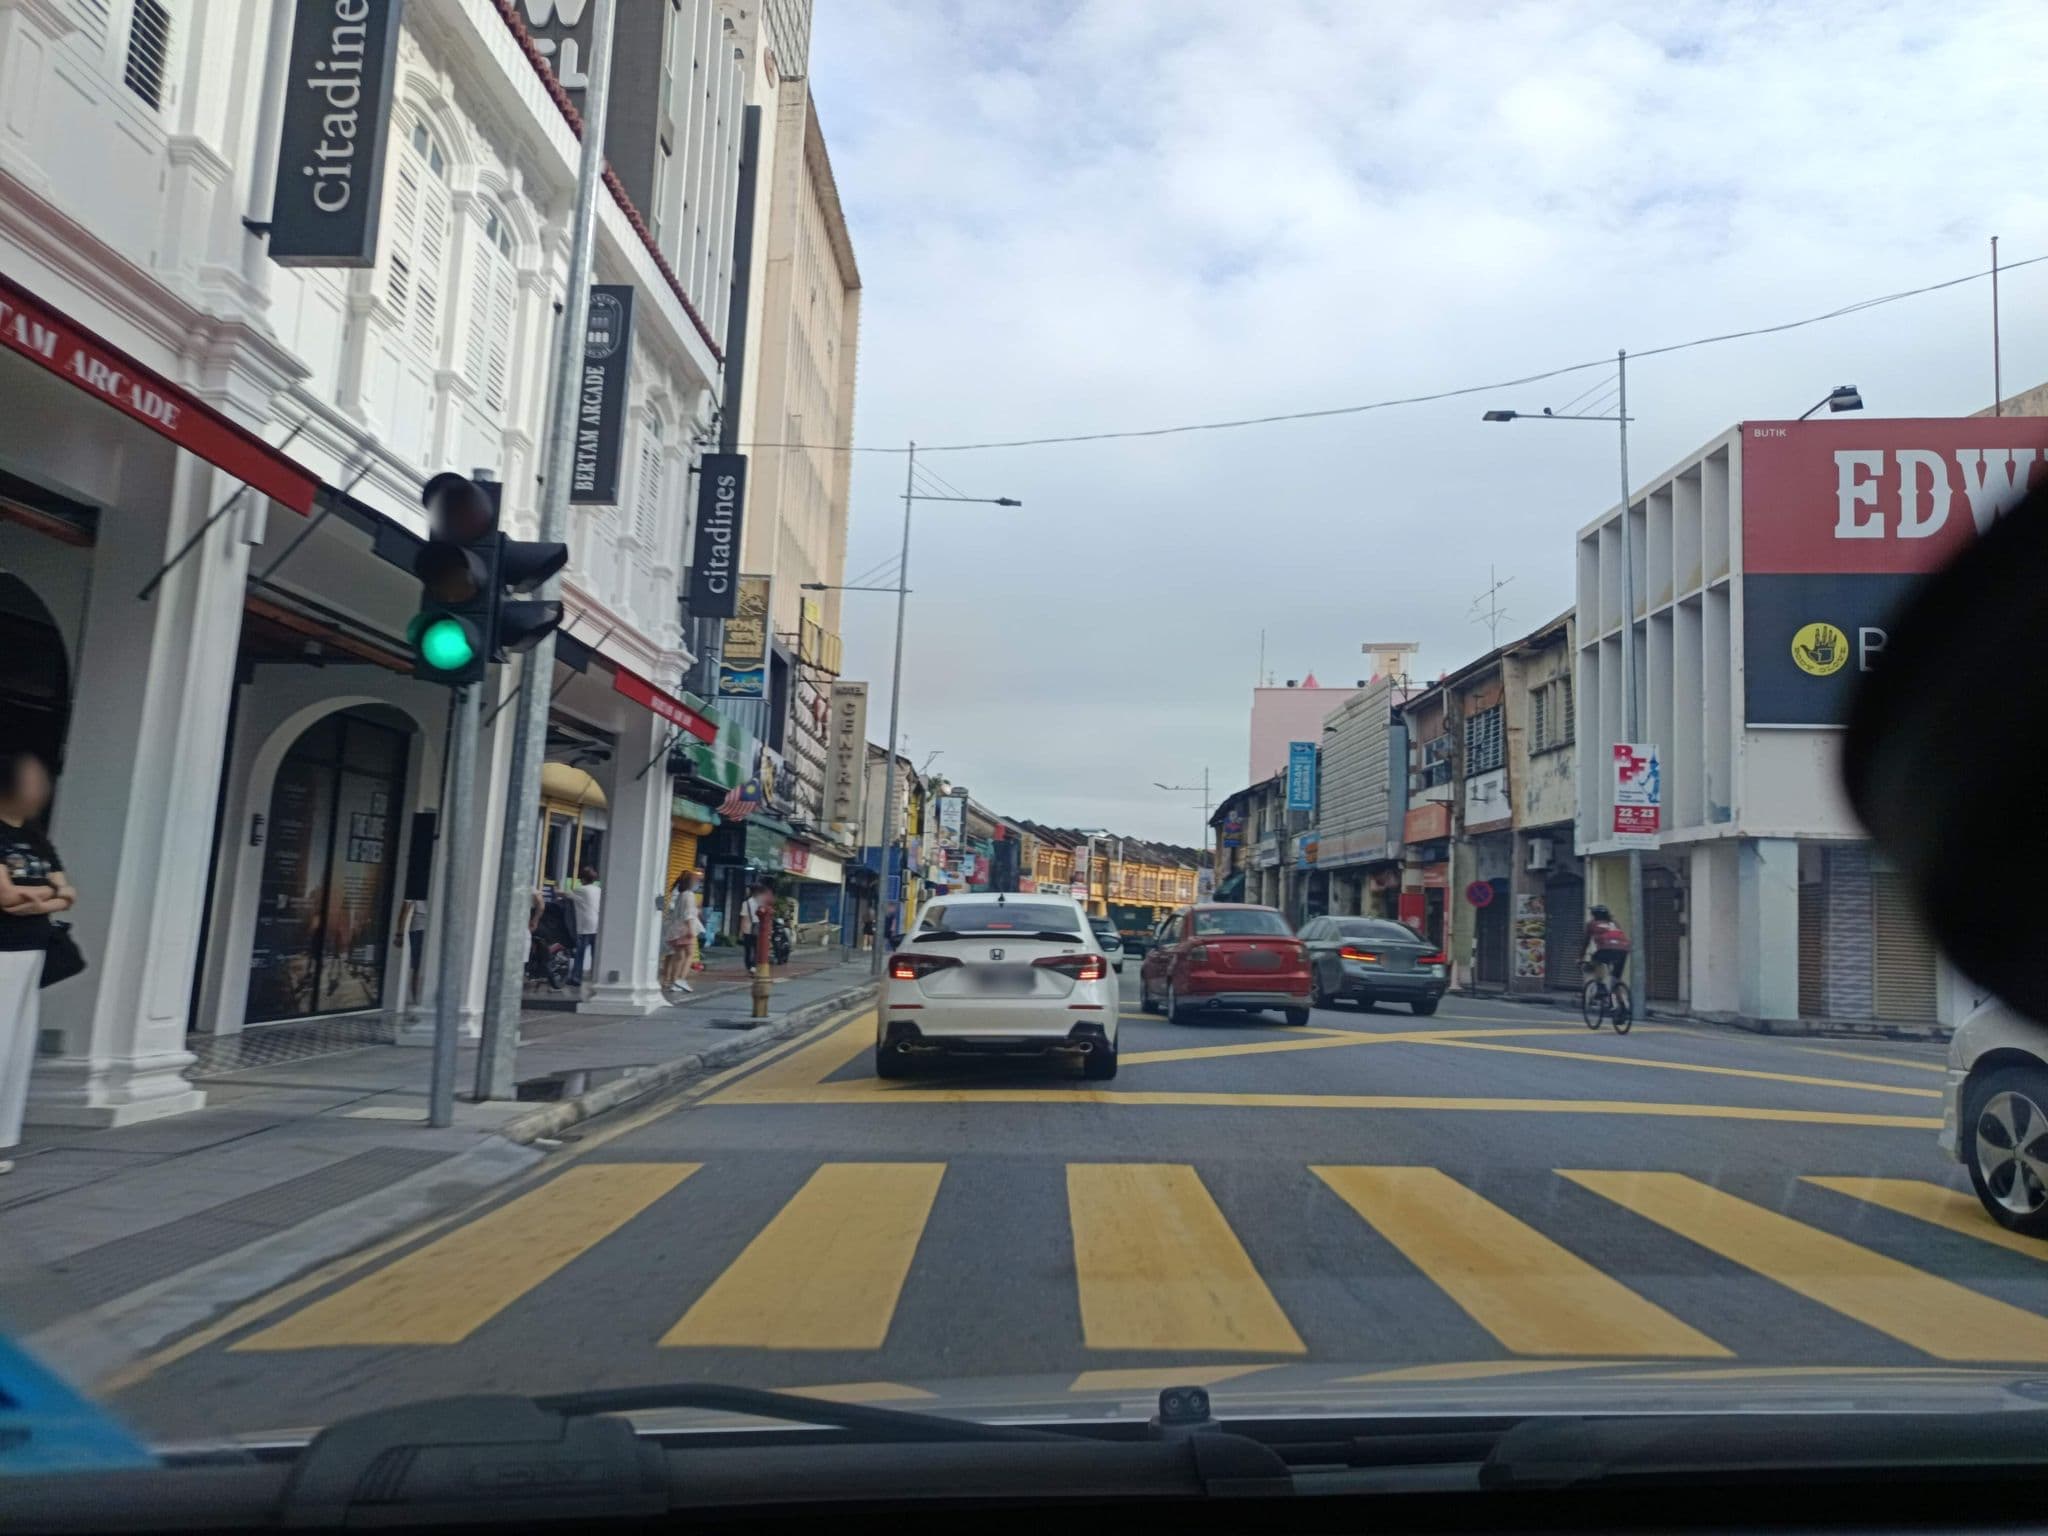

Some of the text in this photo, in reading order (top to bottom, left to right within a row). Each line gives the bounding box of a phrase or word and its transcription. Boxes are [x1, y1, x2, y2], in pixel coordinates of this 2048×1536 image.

[64, 350, 182, 430] ARCADE
[582, 365, 606, 426] ARCADE
[574, 429, 600, 492] BERTAM
[1754, 428, 1787, 437] BUTIK
[1833, 448, 2048, 539] EDW
[703, 474, 737, 594] citadines
[1618, 808, 1633, 817] 22
